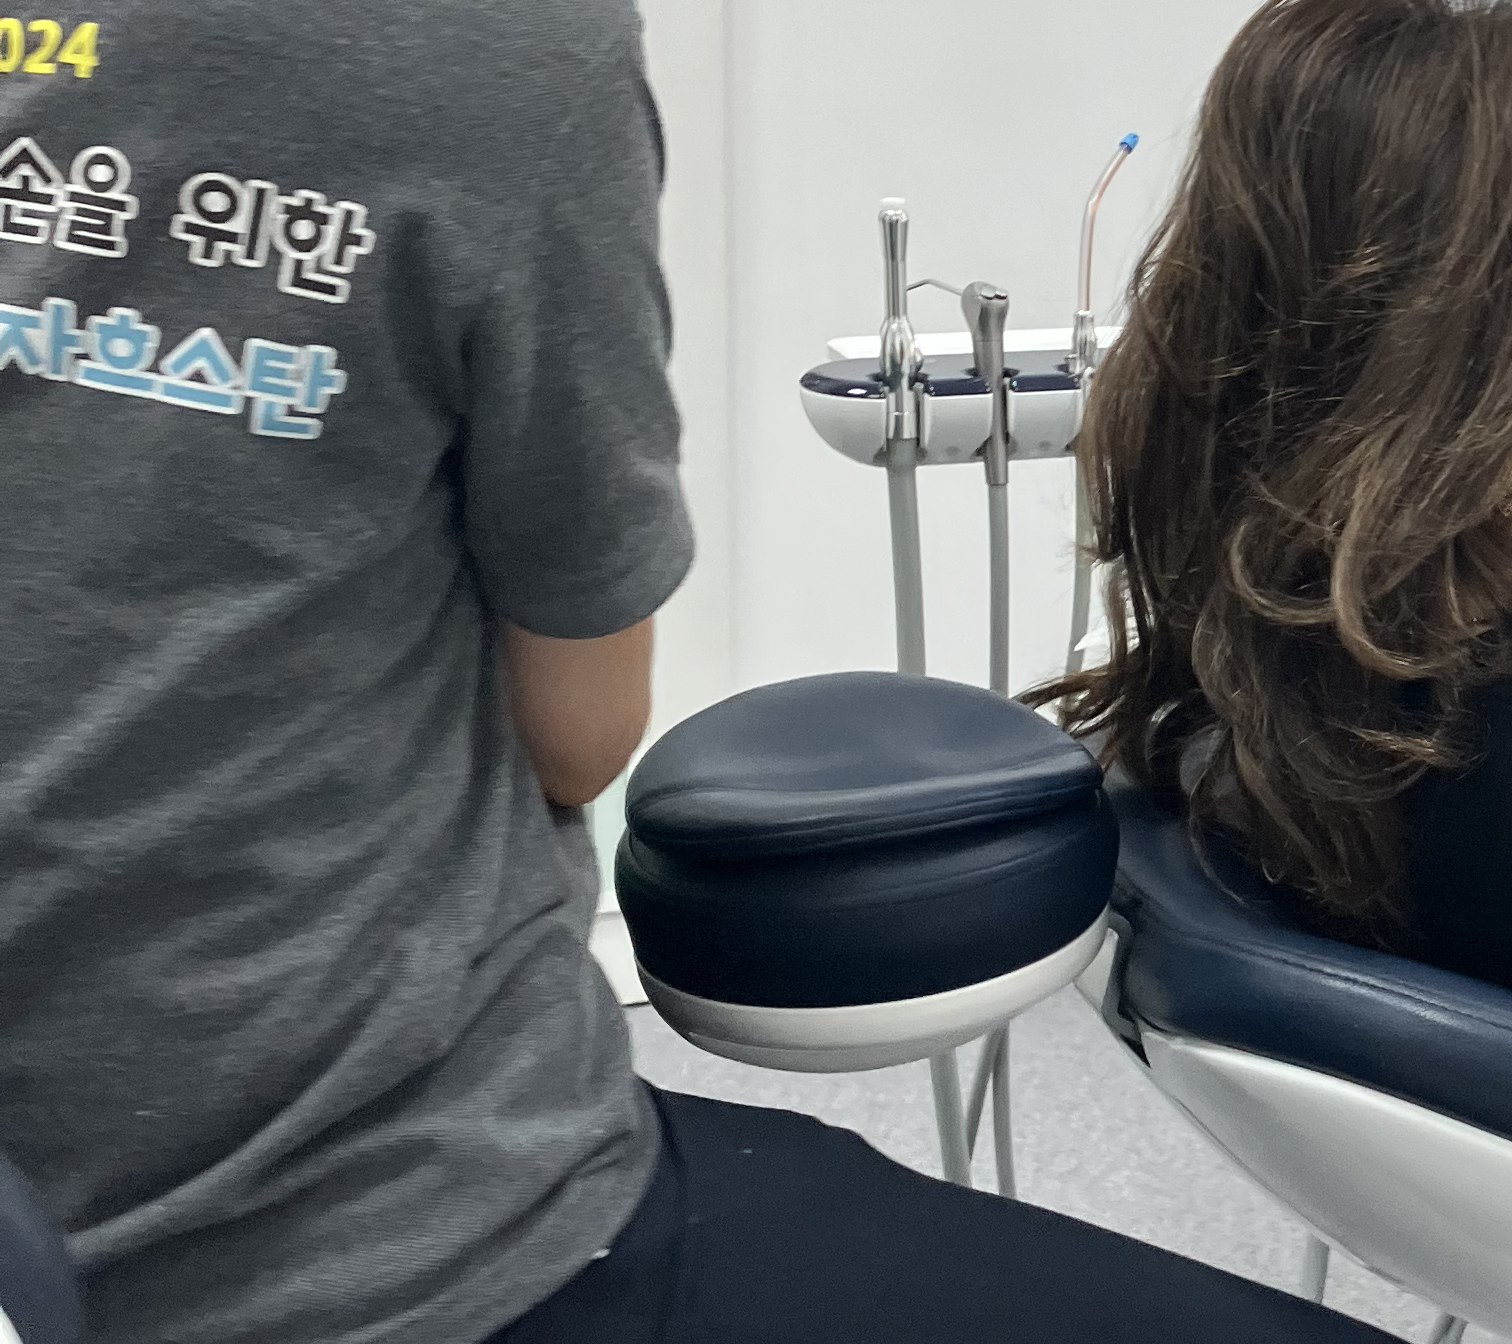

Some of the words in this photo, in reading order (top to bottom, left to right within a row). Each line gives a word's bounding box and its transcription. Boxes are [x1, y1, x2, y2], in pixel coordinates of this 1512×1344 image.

[0, 137, 140, 258] 손을
[170, 172, 376, 303] 위한
[0, 297, 348, 440] 자흐스탄
